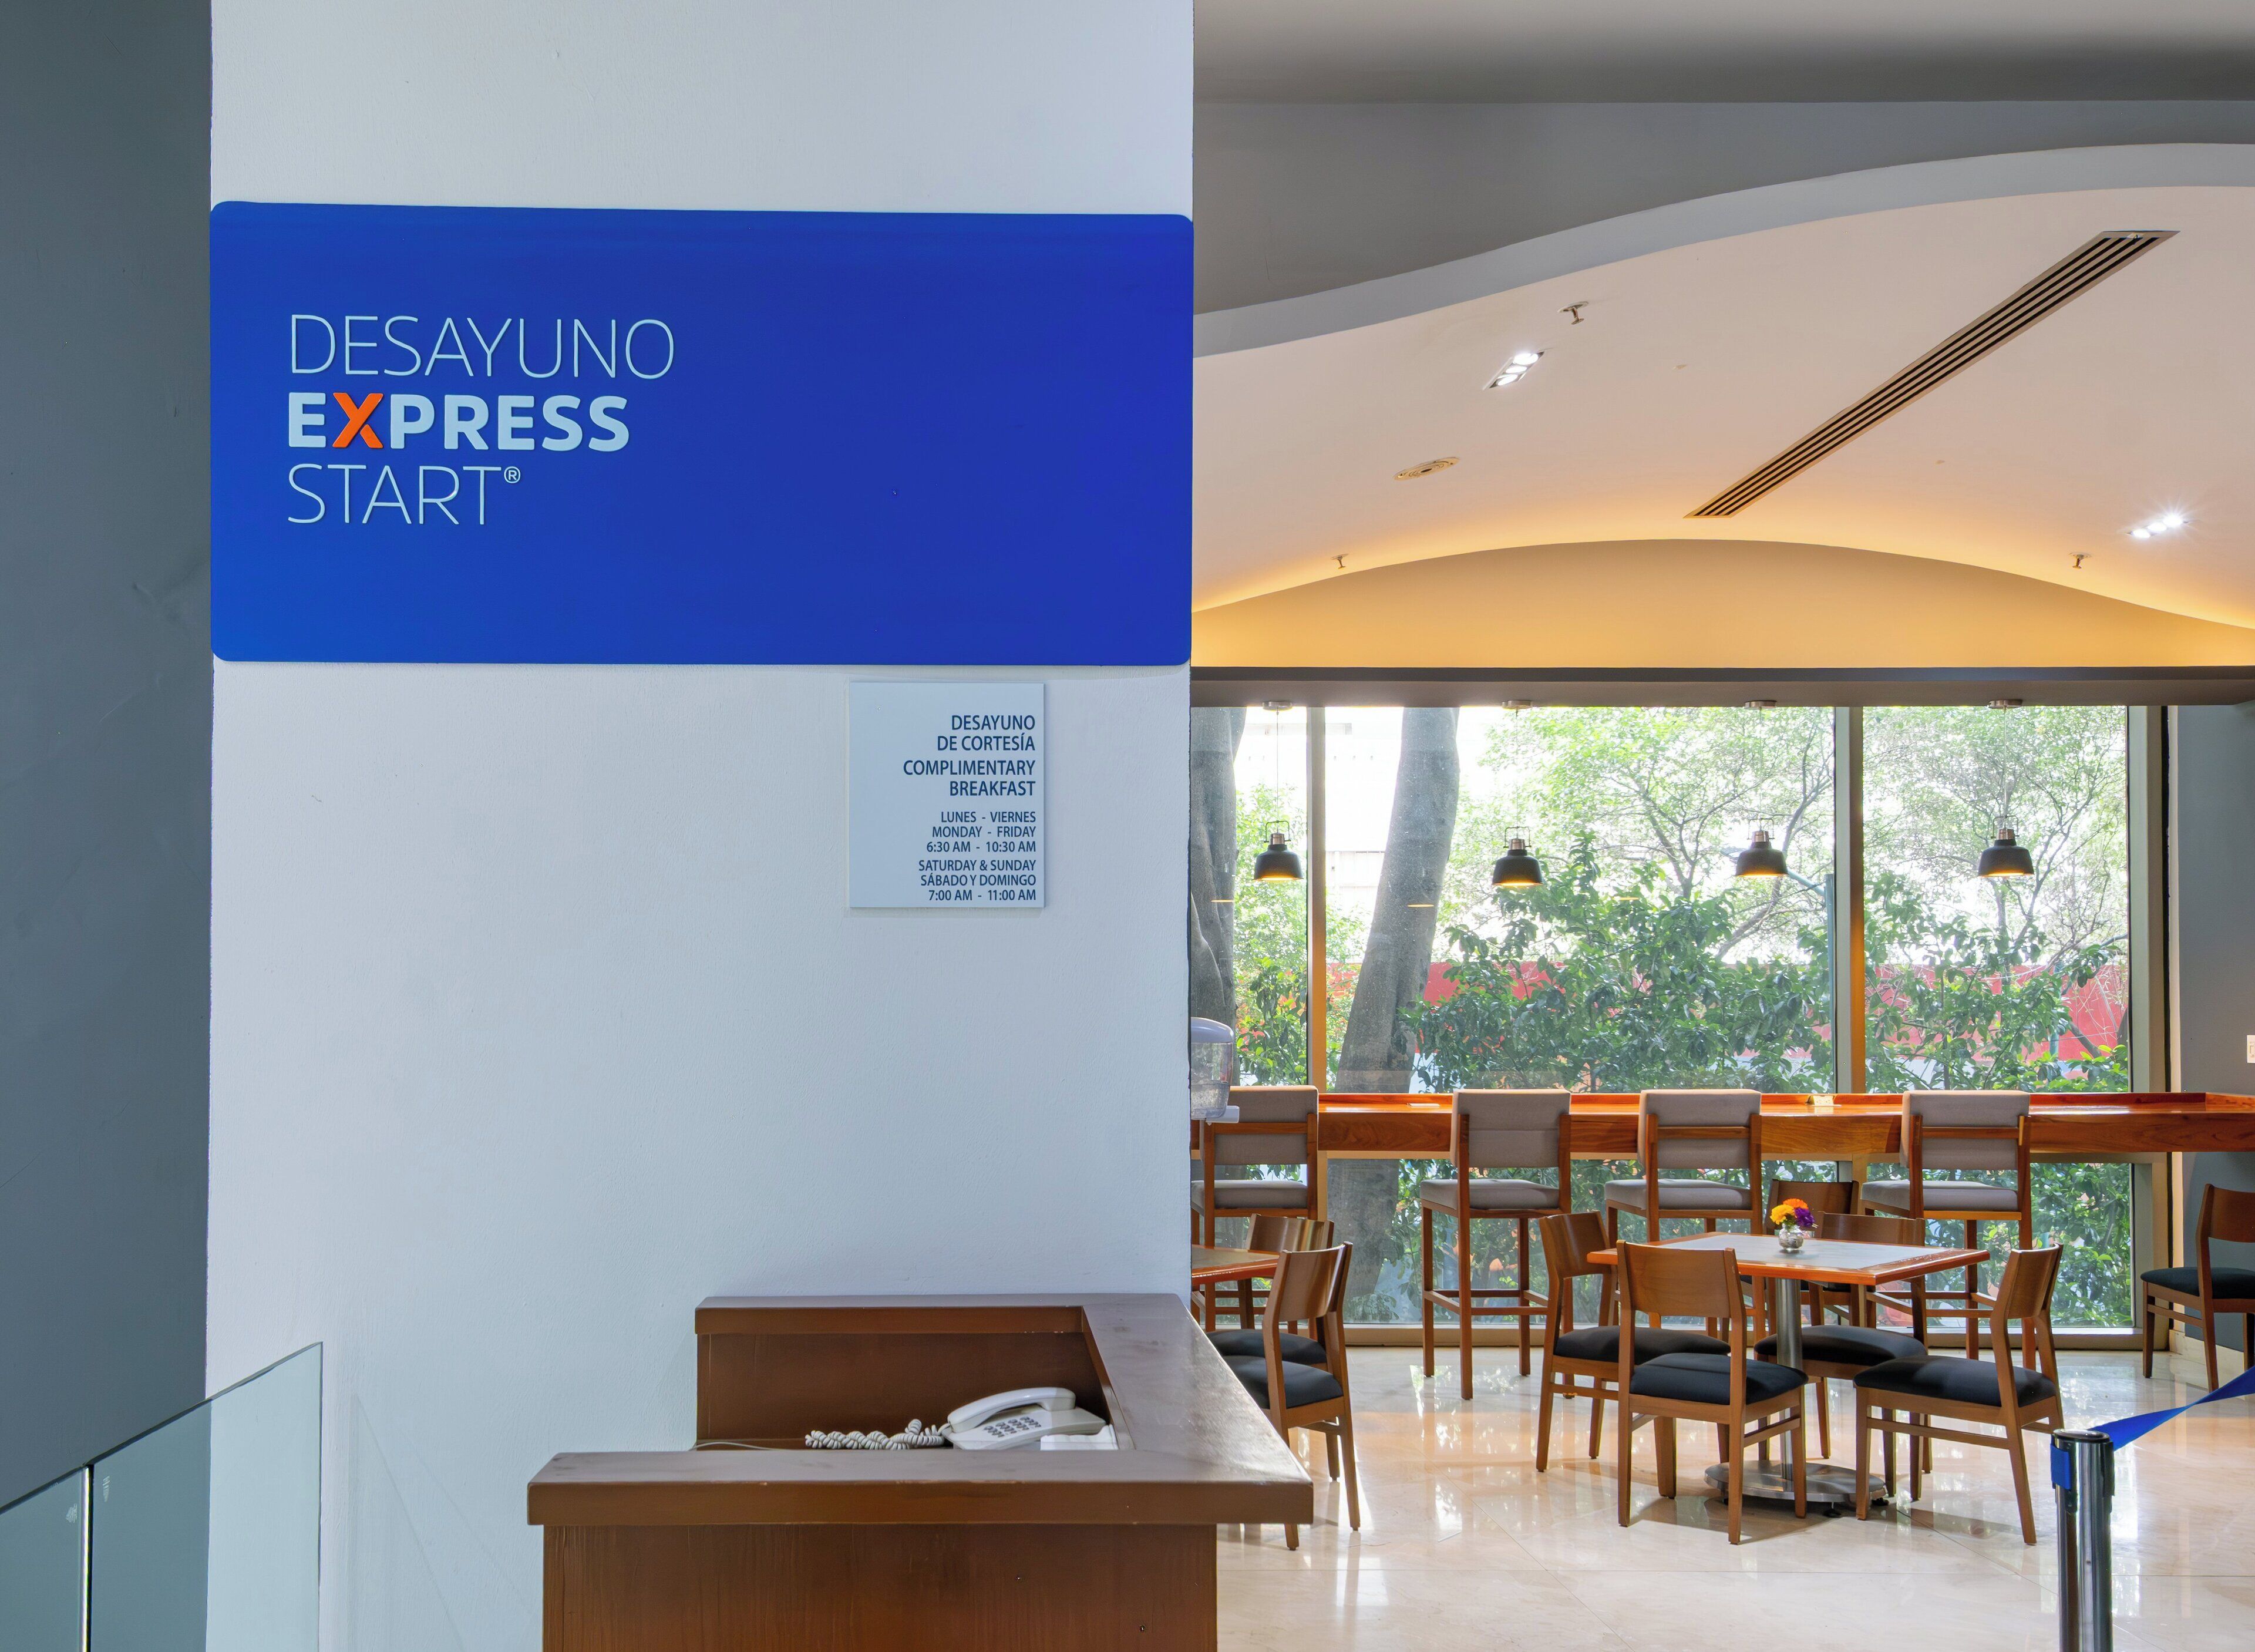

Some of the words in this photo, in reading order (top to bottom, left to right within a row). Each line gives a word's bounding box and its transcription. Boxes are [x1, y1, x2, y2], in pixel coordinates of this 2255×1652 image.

[292, 315, 673, 378] DESAYUNO
[289, 392, 628, 451] EXPRESS
[952, 715, 1035, 730] DESAYUNO
[938, 736, 957, 751] DE
[962, 733, 1035, 751] CORTESÍA
[903, 760, 1035, 775] COMPLIMENTARY
[950, 780, 1036, 796] BREAKFAST
[941, 812, 976, 823] LUNES
[990, 812, 1036, 822] VIERNES
[933, 826, 982, 837] MONDAY
[997, 826, 1036, 837] FRIDAY
[927, 842, 950, 852] 6:30
[953, 841, 970, 852] AM
[986, 842, 1015, 852] 10:30
[1018, 841, 1036, 852] AM
[919, 860, 977, 871] SATURDAY
[980, 860, 987, 871] &
[991, 860, 1036, 871] SUNDAY
[921, 873, 968, 886] SÁBADO
[970, 874, 977, 886] Y
[980, 874, 1036, 886] DOMINGO
[929, 890, 951, 901] 7:00
[954, 890, 972, 900] AM
[988, 890, 1015, 900] 11:00
[1018, 889, 1036, 900] AM
